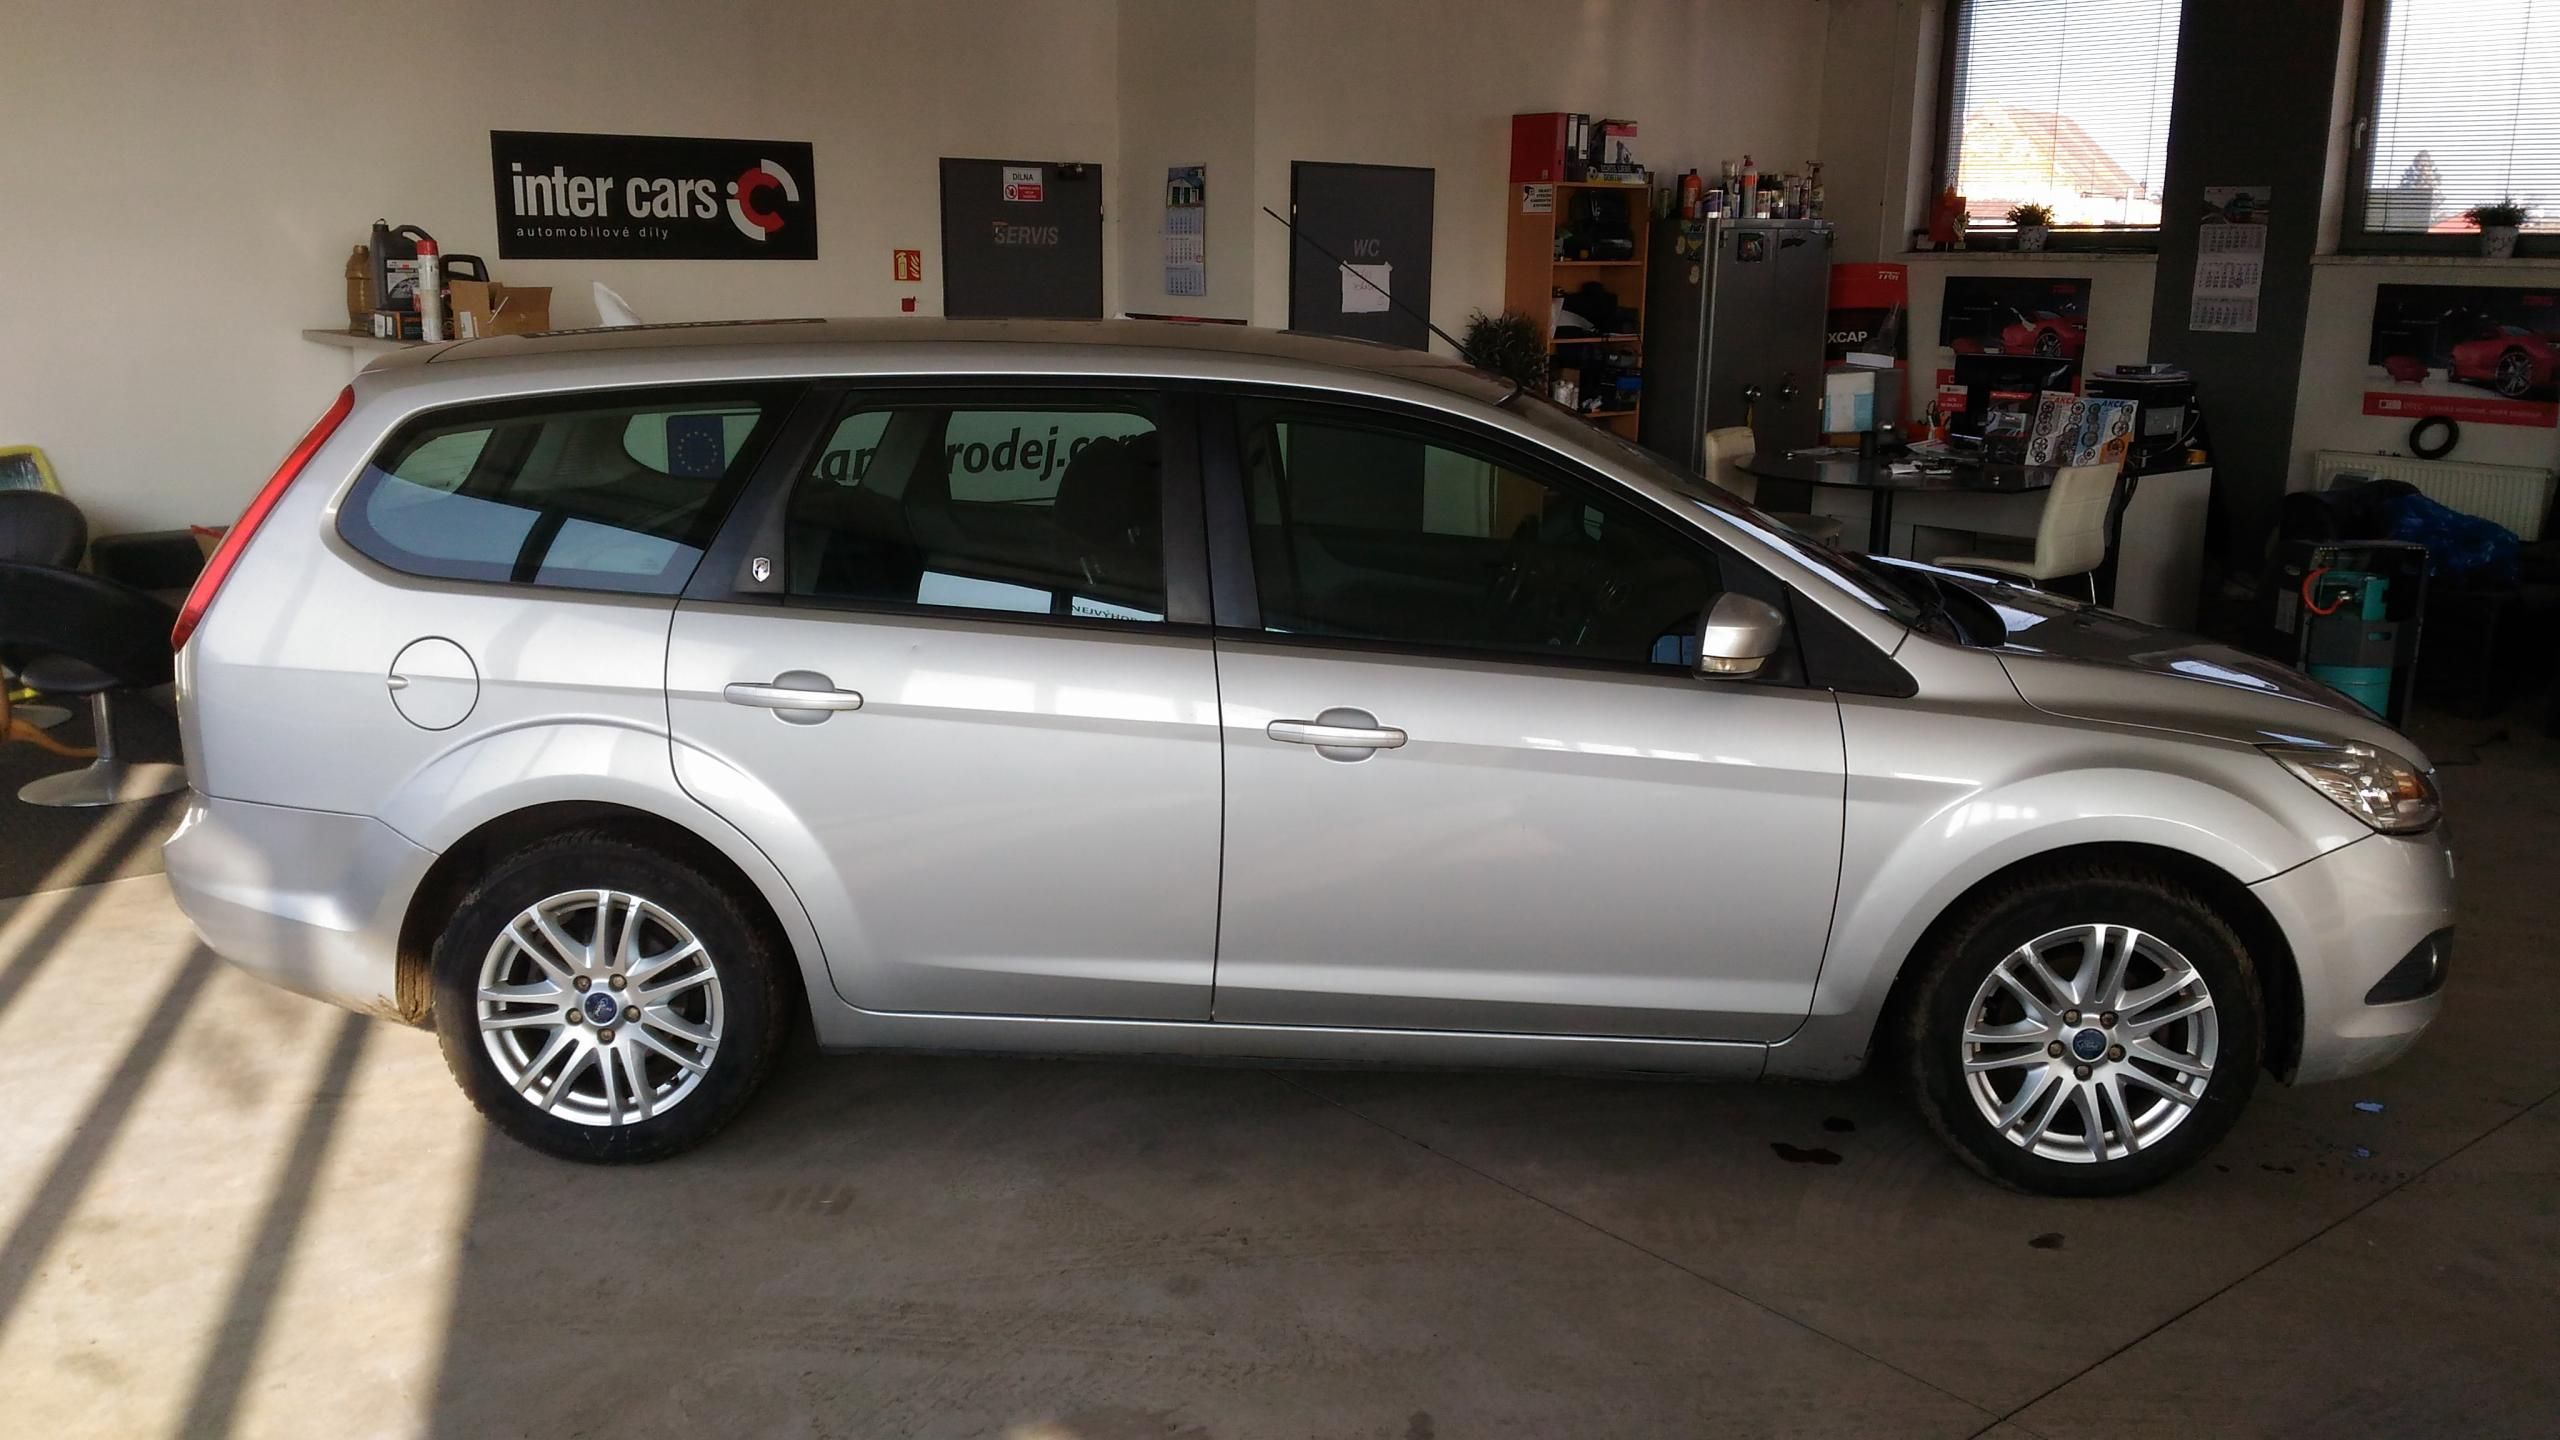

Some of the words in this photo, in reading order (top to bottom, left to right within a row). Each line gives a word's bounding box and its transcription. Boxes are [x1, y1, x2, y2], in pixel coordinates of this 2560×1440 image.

[511, 162, 614, 217] inter
[626, 177, 718, 219] cars
[516, 226, 630, 239] automobilové
[994, 226, 1058, 245] SERVIS
[1353, 239, 1380, 257] WC
